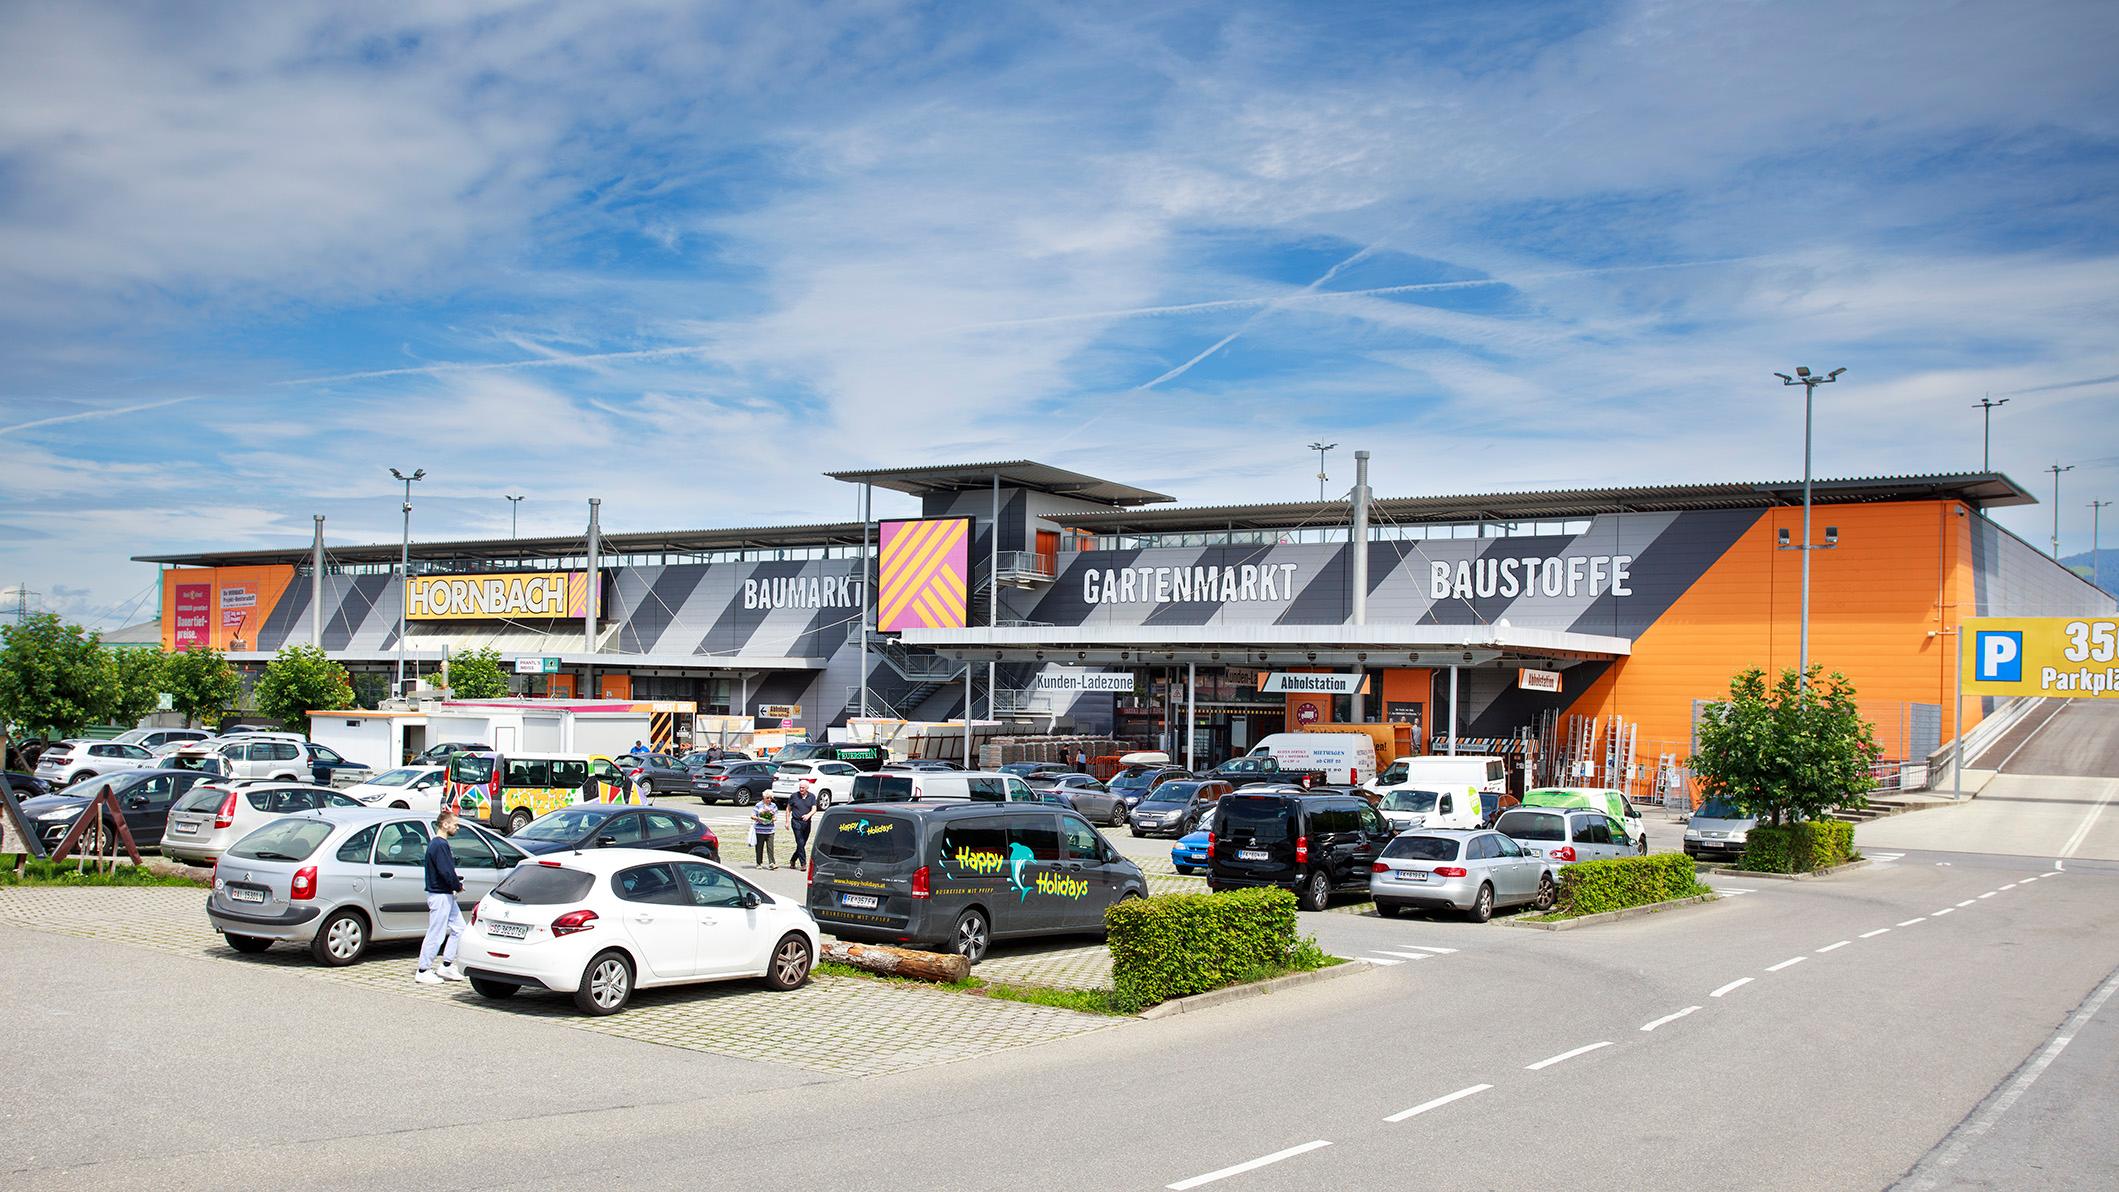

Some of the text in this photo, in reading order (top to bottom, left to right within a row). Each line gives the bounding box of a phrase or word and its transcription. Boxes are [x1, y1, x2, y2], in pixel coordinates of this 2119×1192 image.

[1083, 563, 1298, 604] GARTENMARKT
[1430, 555, 1633, 600] BAUSTOFFE
[408, 577, 564, 615] HORNBACH
[177, 615, 208, 628] Dauertief-
[177, 628, 197, 642] preise.
[2063, 620, 2119, 662] 35
[1984, 635, 2017, 677] P
[1037, 674, 1133, 690] Kunden-Ladezone
[1281, 676, 1346, 690] Abholstation
[839, 822, 894, 836] Happy Holidays
[955, 845, 1004, 875] Happy
[1036, 872, 1089, 900] Holidays
[822, 910, 854, 919] BUSREISEN
[871, 915, 891, 923] PFIFF
